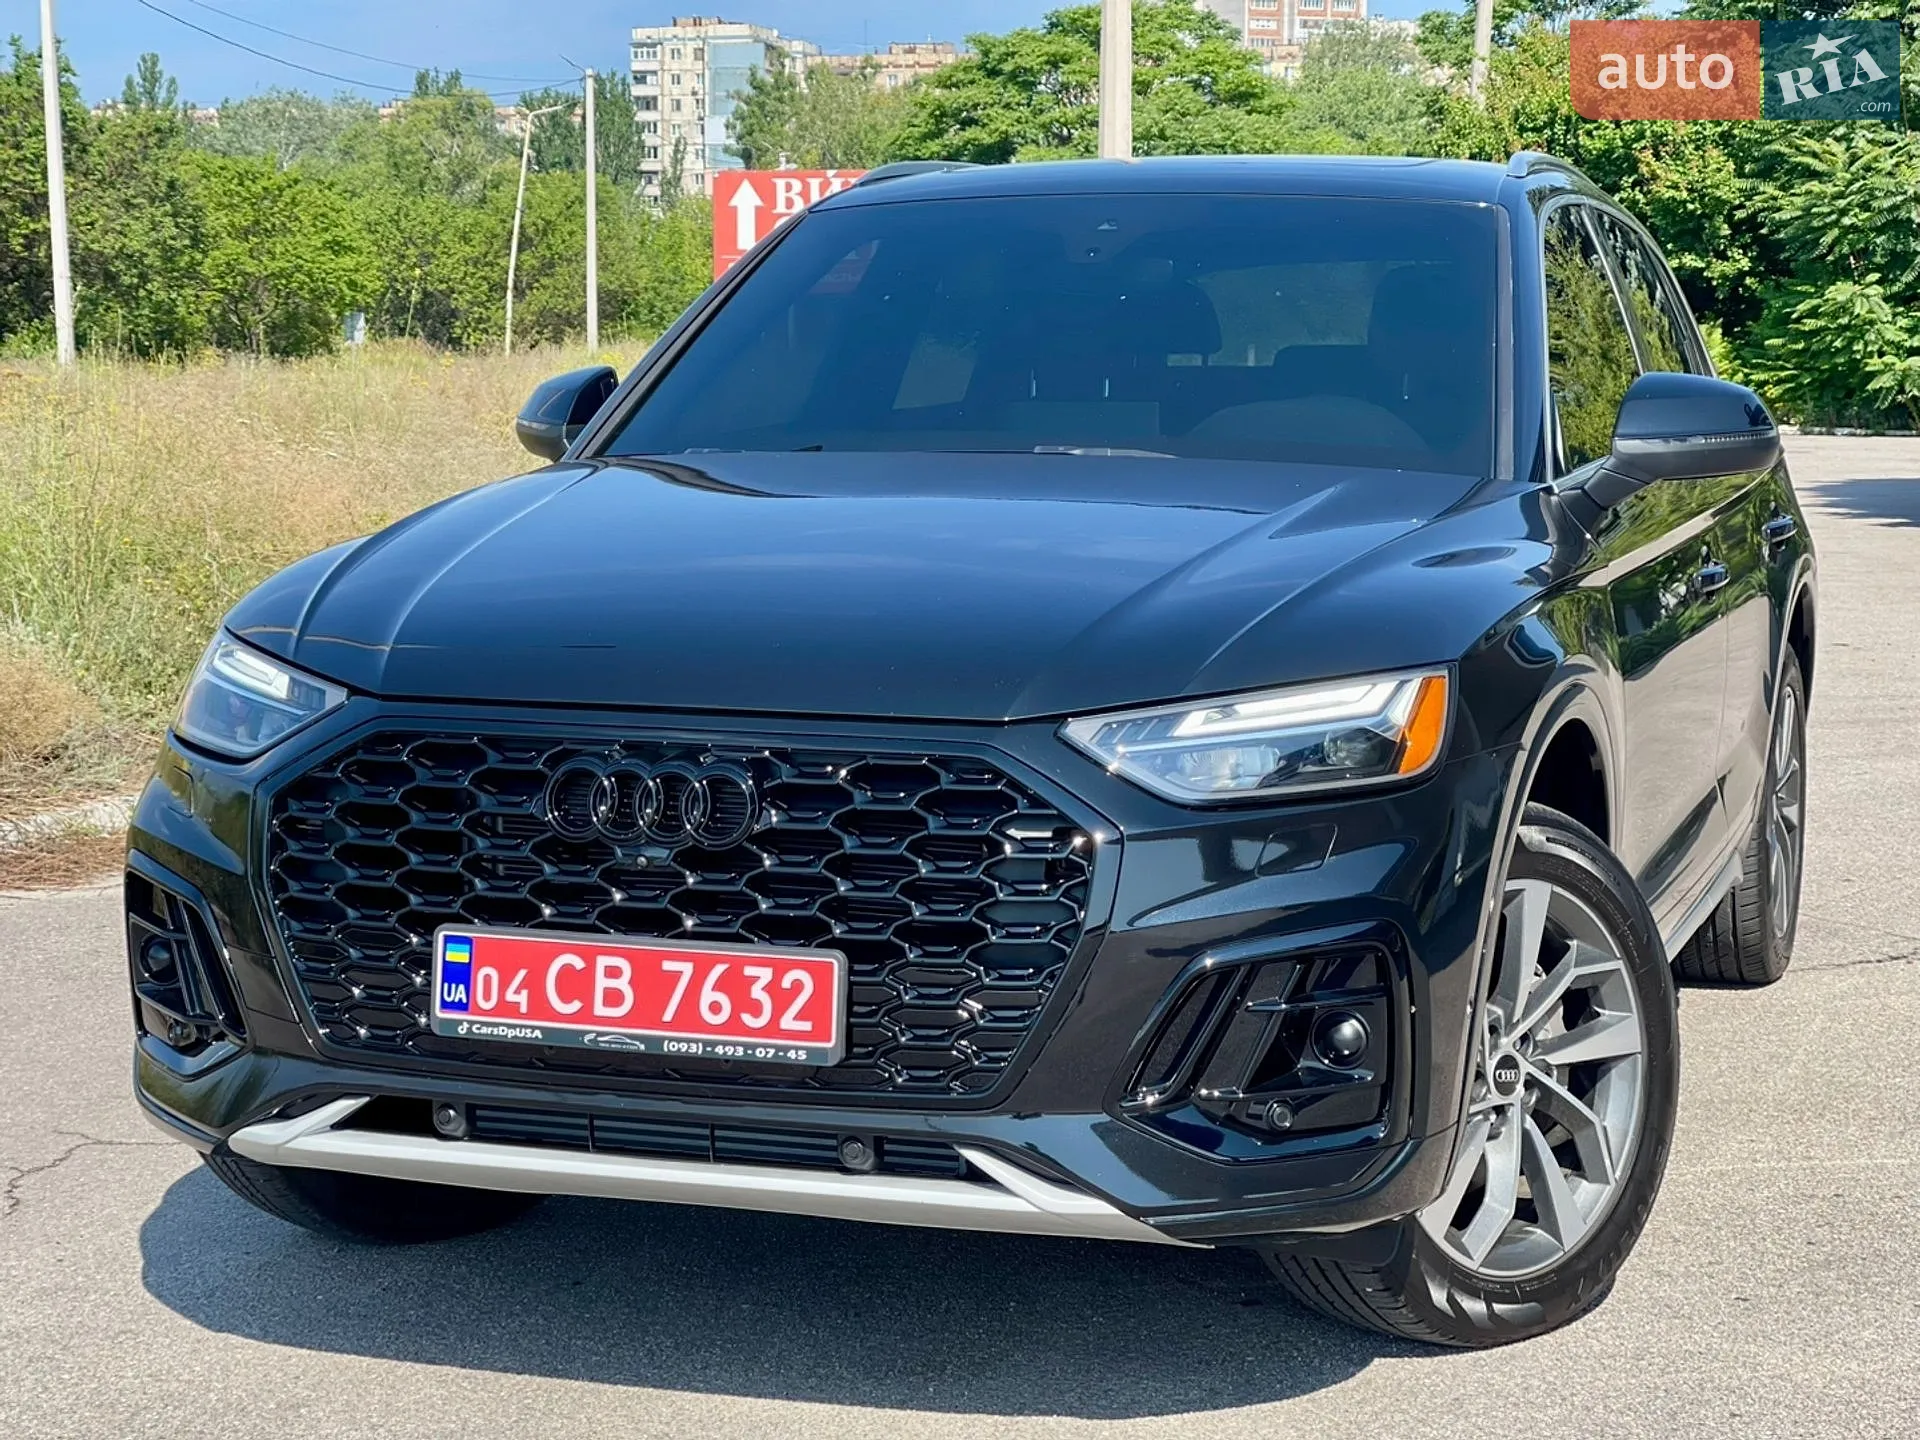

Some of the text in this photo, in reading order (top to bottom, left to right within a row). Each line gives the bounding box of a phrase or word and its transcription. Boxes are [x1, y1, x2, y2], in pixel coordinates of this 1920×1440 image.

[443, 982, 467, 1004] UA
[476, 952, 815, 1032] 04 CB 7632
[471, 1023, 543, 1039] CarsDpUSA
[663, 1040, 703, 1055] (093)
[714, 1044, 744, 1056] 493
[786, 1049, 808, 1060] 45
